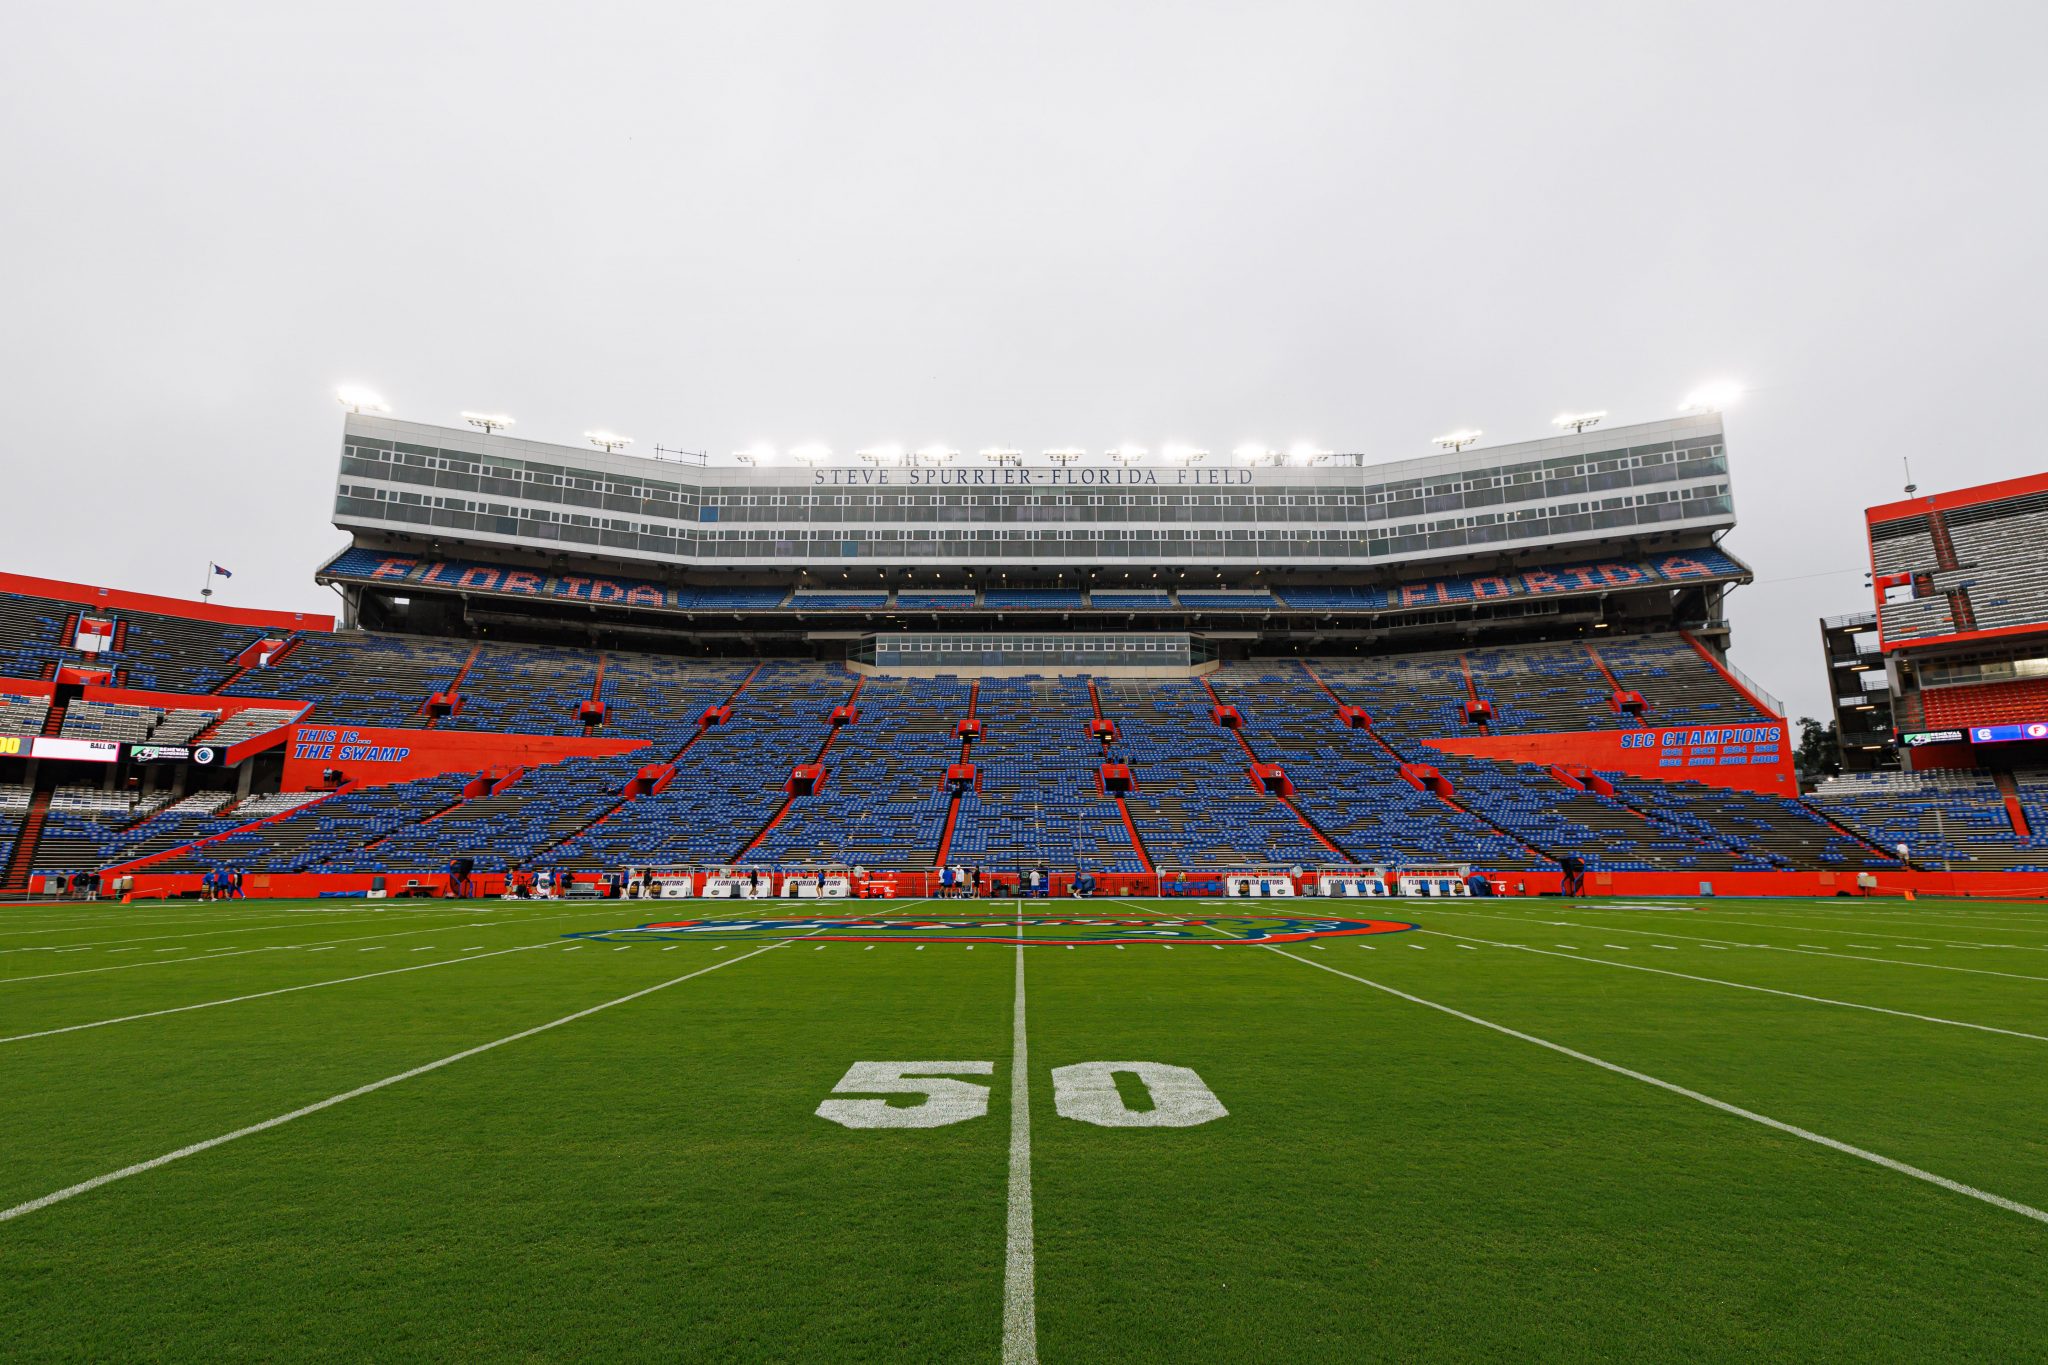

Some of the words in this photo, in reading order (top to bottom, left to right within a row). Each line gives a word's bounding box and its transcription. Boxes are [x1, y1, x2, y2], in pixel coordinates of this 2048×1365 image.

[815, 469, 889, 485] STEVE
[910, 469, 1158, 485] SPURRIER-FLORIDA
[1178, 468, 1253, 485] FIELD
[370, 558, 664, 608] FLORIDA
[1401, 557, 1712, 608] FLORIDA
[296, 729, 337, 742] THIS
[340, 731, 371, 744] IS...
[1620, 733, 1655, 748] SEC
[1661, 727, 1780, 747] CHAMPIONS
[294, 744, 335, 759] THE
[338, 746, 410, 762] SWAMP
